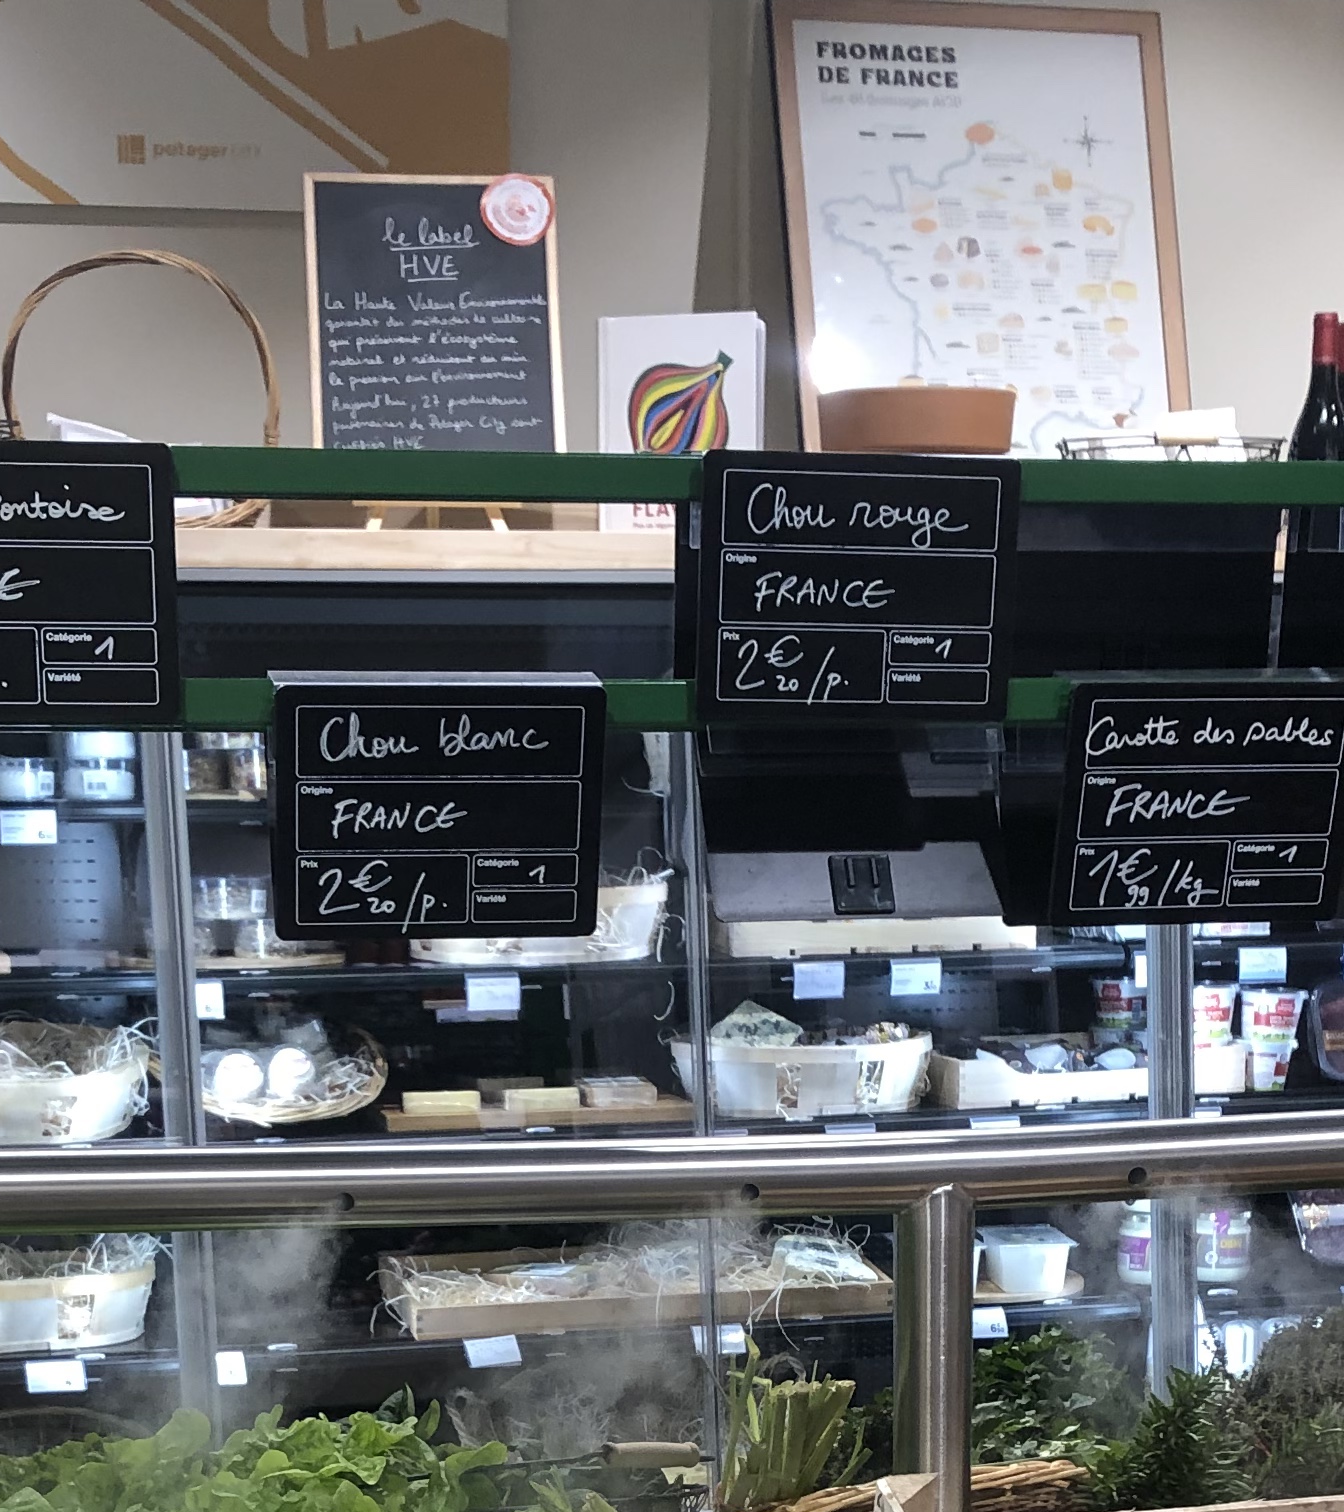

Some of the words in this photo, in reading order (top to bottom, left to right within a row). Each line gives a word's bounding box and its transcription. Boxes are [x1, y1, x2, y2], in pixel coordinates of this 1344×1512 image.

[816, 40, 957, 63] FROMAGES
[818, 66, 849, 84] DE
[861, 67, 959, 89] FRANCE
[382, 217, 411, 246] le
[418, 217, 480, 246] label
[400, 254, 459, 278] HVE
[324, 292, 345, 310] La
[355, 292, 398, 311] Haute
[747, 483, 836, 534] Chou
[849, 502, 969, 549] rouge
[726, 554, 757, 564] Origine
[754, 572, 895, 612] FRANCE
[46, 632, 93, 643] Catégorie
[94, 636, 113, 660] 1
[723, 632, 740, 641] Prix
[894, 635, 934, 646] Catégorie
[935, 638, 952, 659] 1
[47, 673, 81, 682] Variété
[892, 674, 921, 682] Variété
[319, 712, 419, 762] Chou
[439, 714, 549, 757] blanc
[1086, 716, 1180, 755] Carotte
[1193, 717, 1235, 744] des
[1243, 717, 1334, 747] sables
[301, 786, 333, 796] Origine
[1087, 776, 1116, 785] Origine
[1105, 783, 1251, 827] FRANCE
[330, 799, 468, 839] FRANCE
[301, 860, 318, 868] Prix
[1279, 845, 1297, 863] 1
[477, 858, 519, 868] Catégorie
[529, 865, 545, 884] 1
[476, 894, 506, 903] Variété
